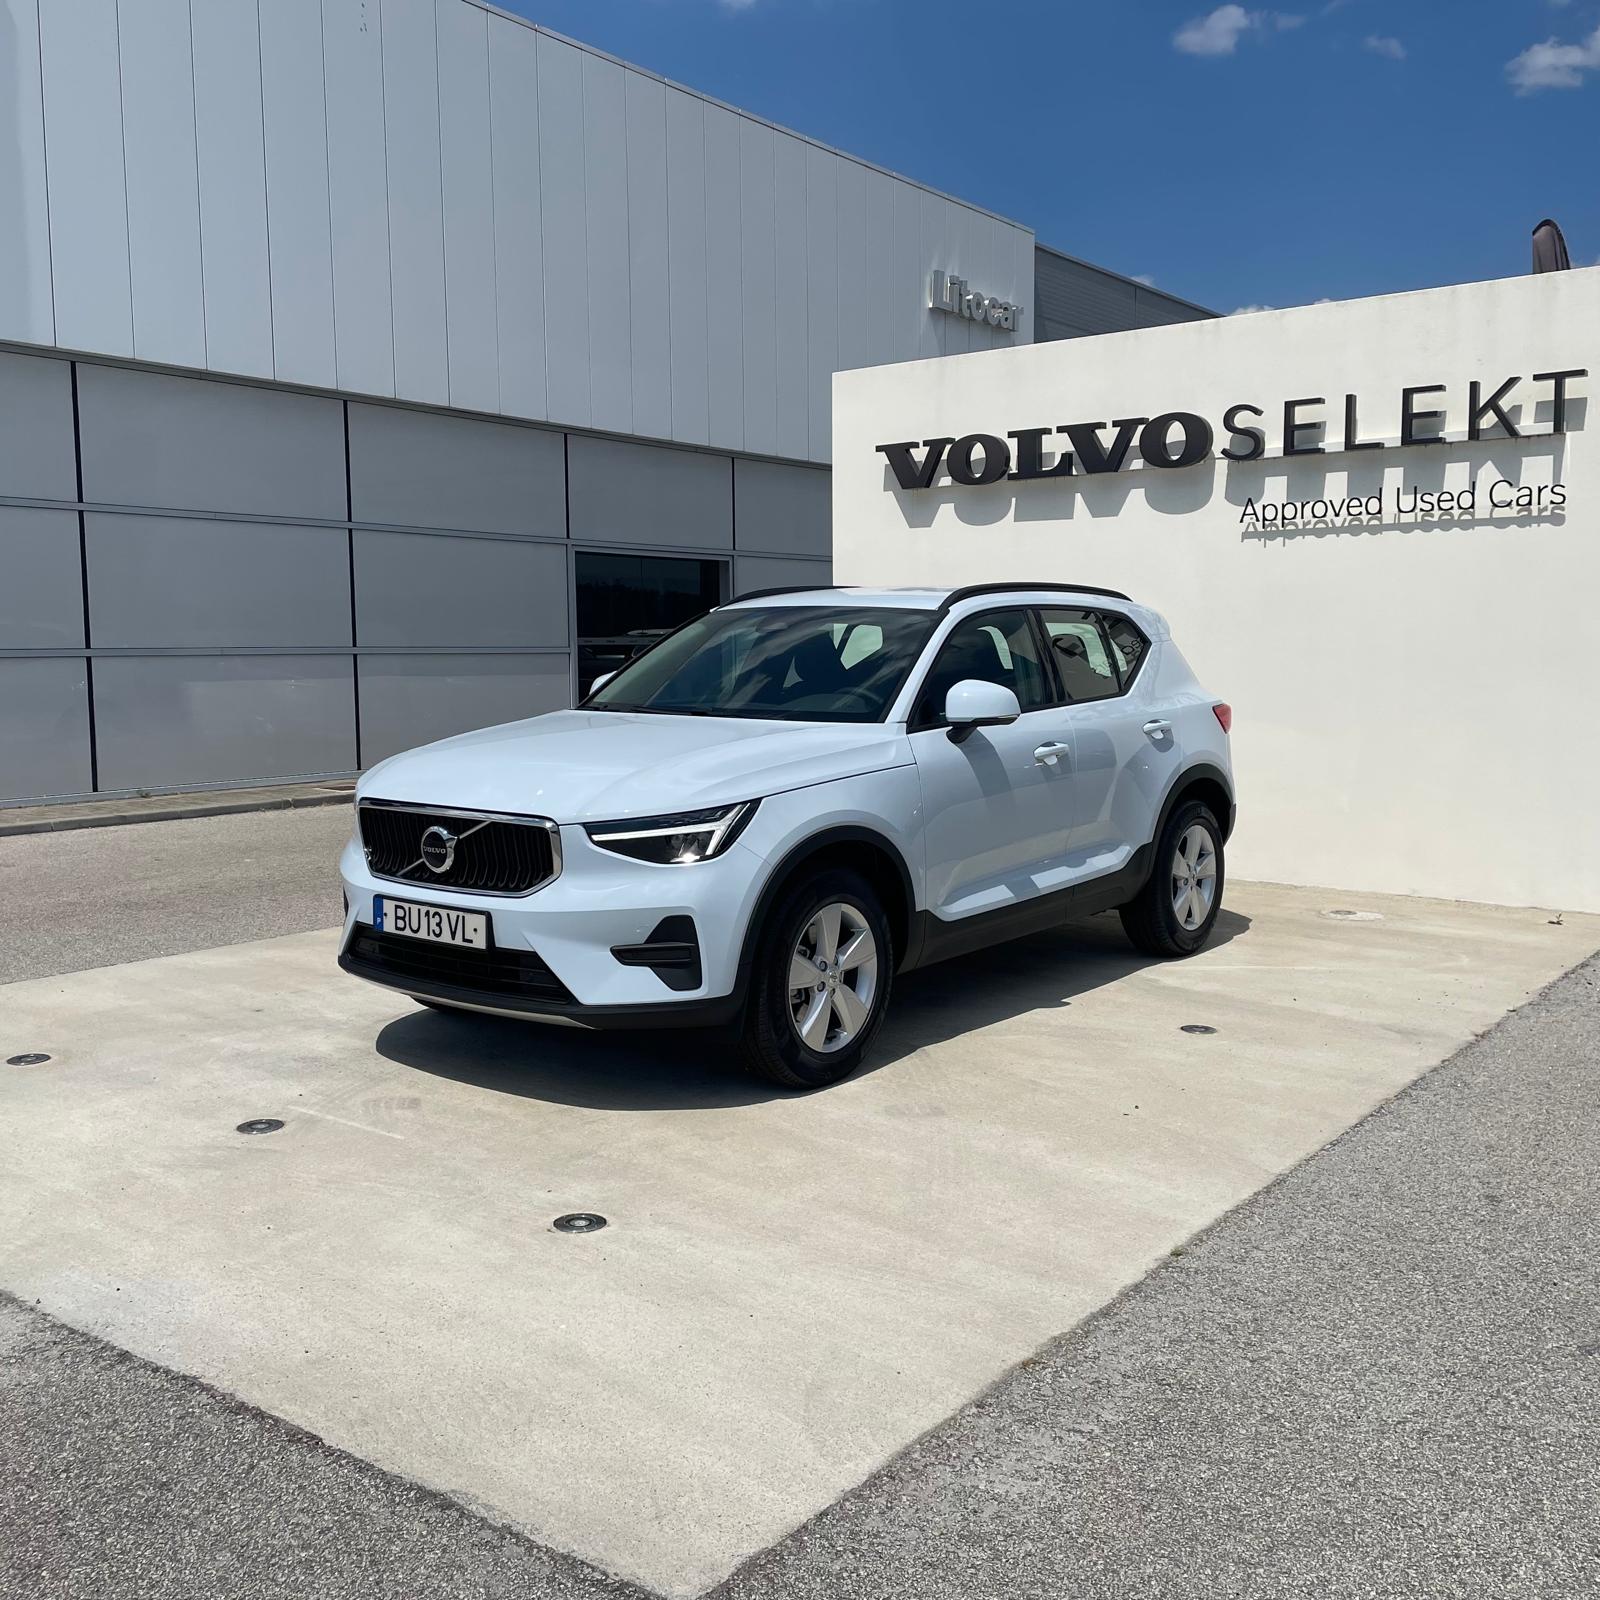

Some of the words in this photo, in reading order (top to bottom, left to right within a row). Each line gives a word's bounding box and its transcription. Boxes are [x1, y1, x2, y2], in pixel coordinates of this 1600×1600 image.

[929, 269, 1024, 332] Litocar
[876, 412, 1213, 489] VOLVO
[1221, 369, 1588, 460] SELEKT
[1239, 487, 1383, 529] Approved
[1396, 481, 1476, 514] Used
[1489, 479, 1567, 509] Cars
[423, 846, 446, 854] VOLVO
